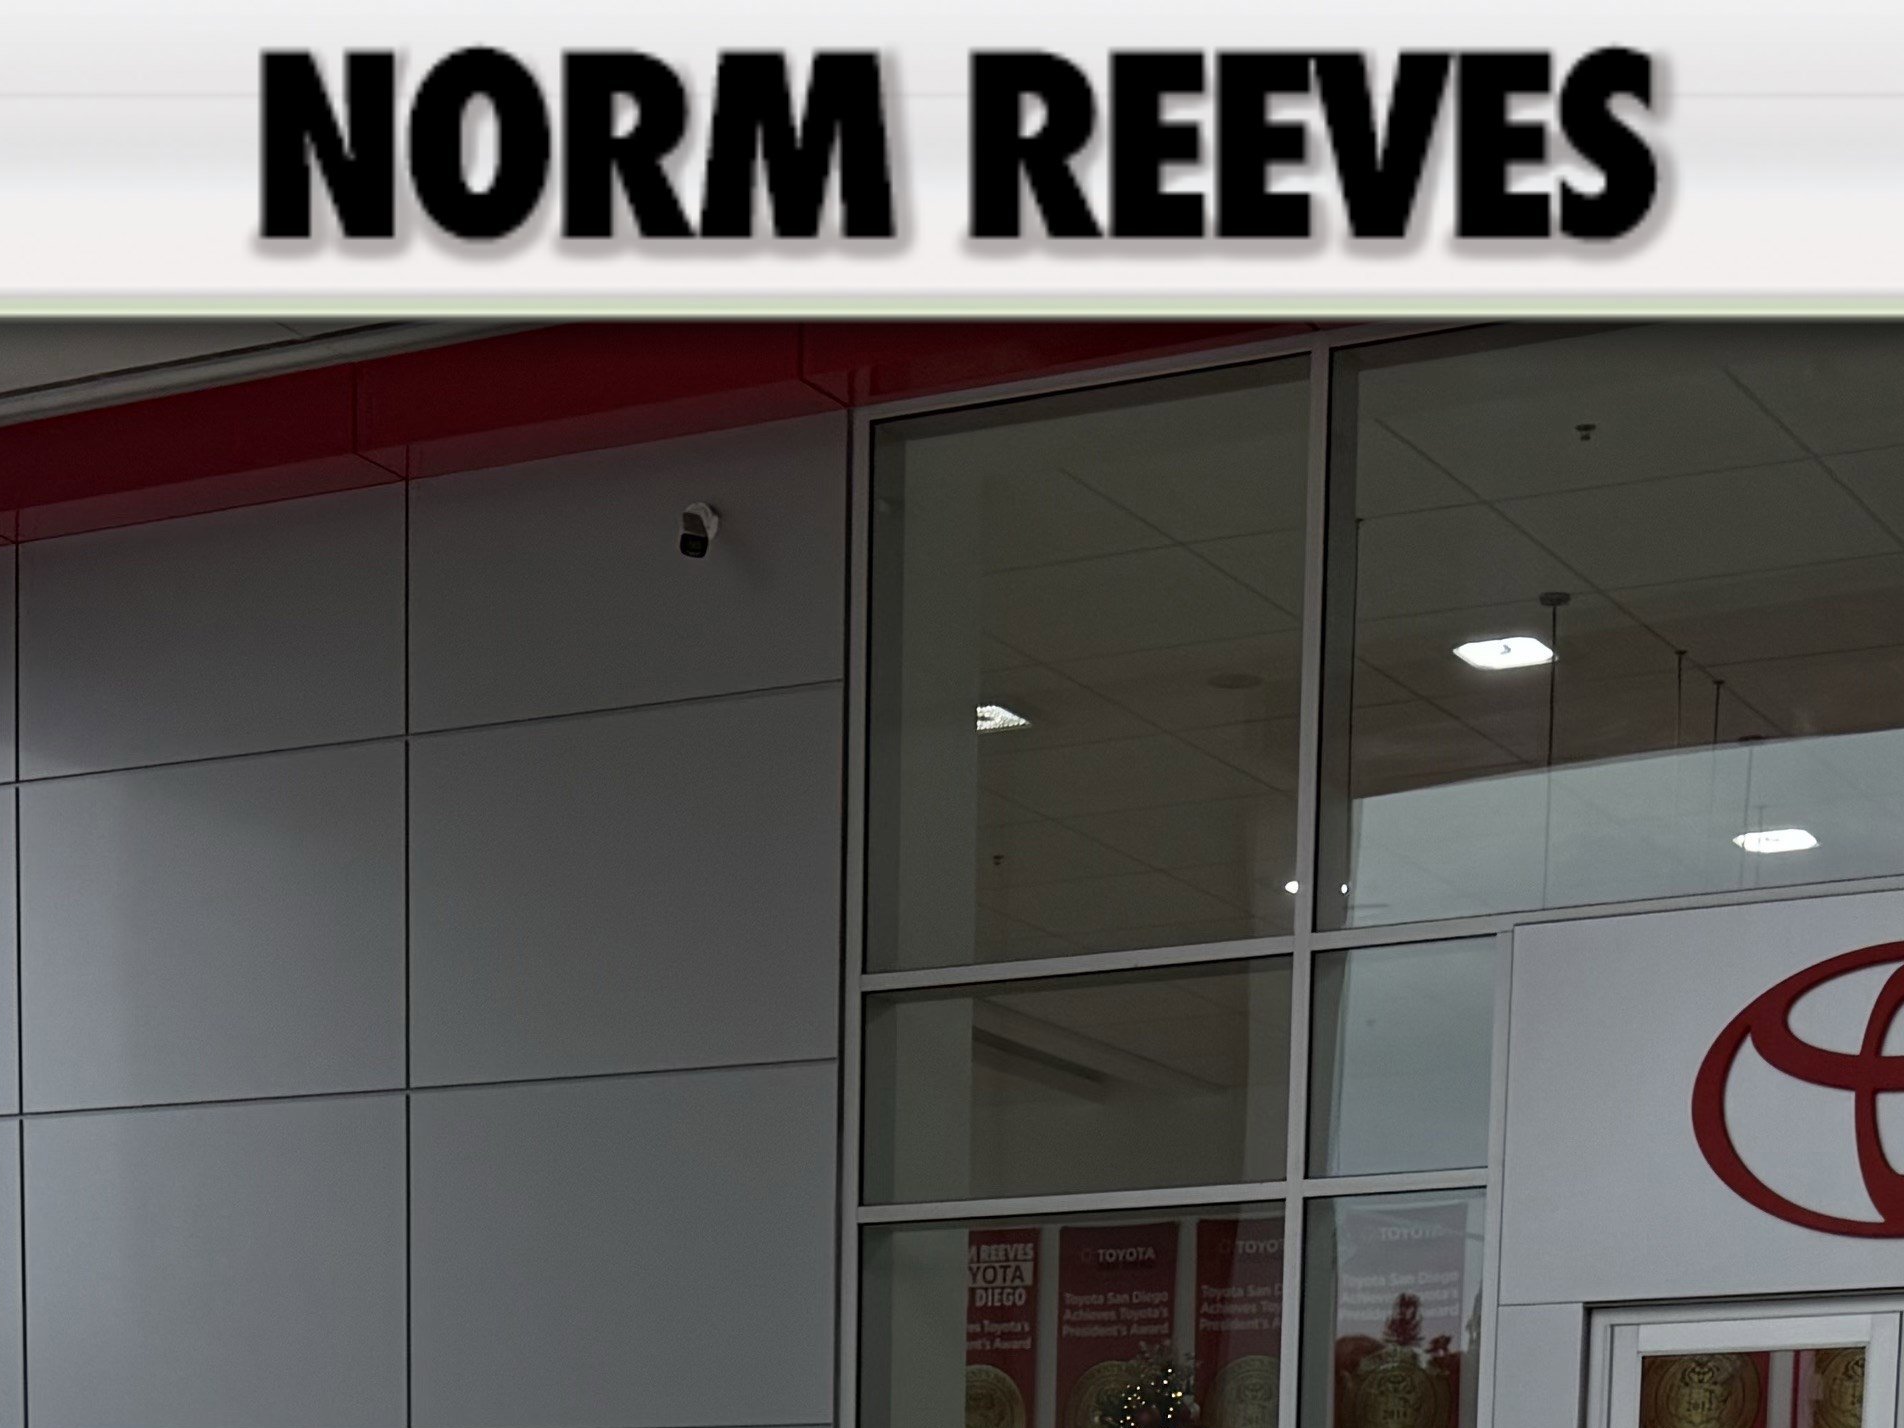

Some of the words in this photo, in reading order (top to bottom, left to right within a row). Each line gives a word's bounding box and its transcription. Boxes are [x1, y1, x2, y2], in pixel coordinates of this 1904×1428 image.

[979, 1243, 1034, 1262] REEVES
[1236, 1239, 1283, 1254] TOYO
[1097, 1247, 1156, 1263] TOYOTA
[975, 1288, 1027, 1307] DIEGO
[1106, 1291, 1130, 1304] San
[1132, 1291, 1169, 1304] Diego
